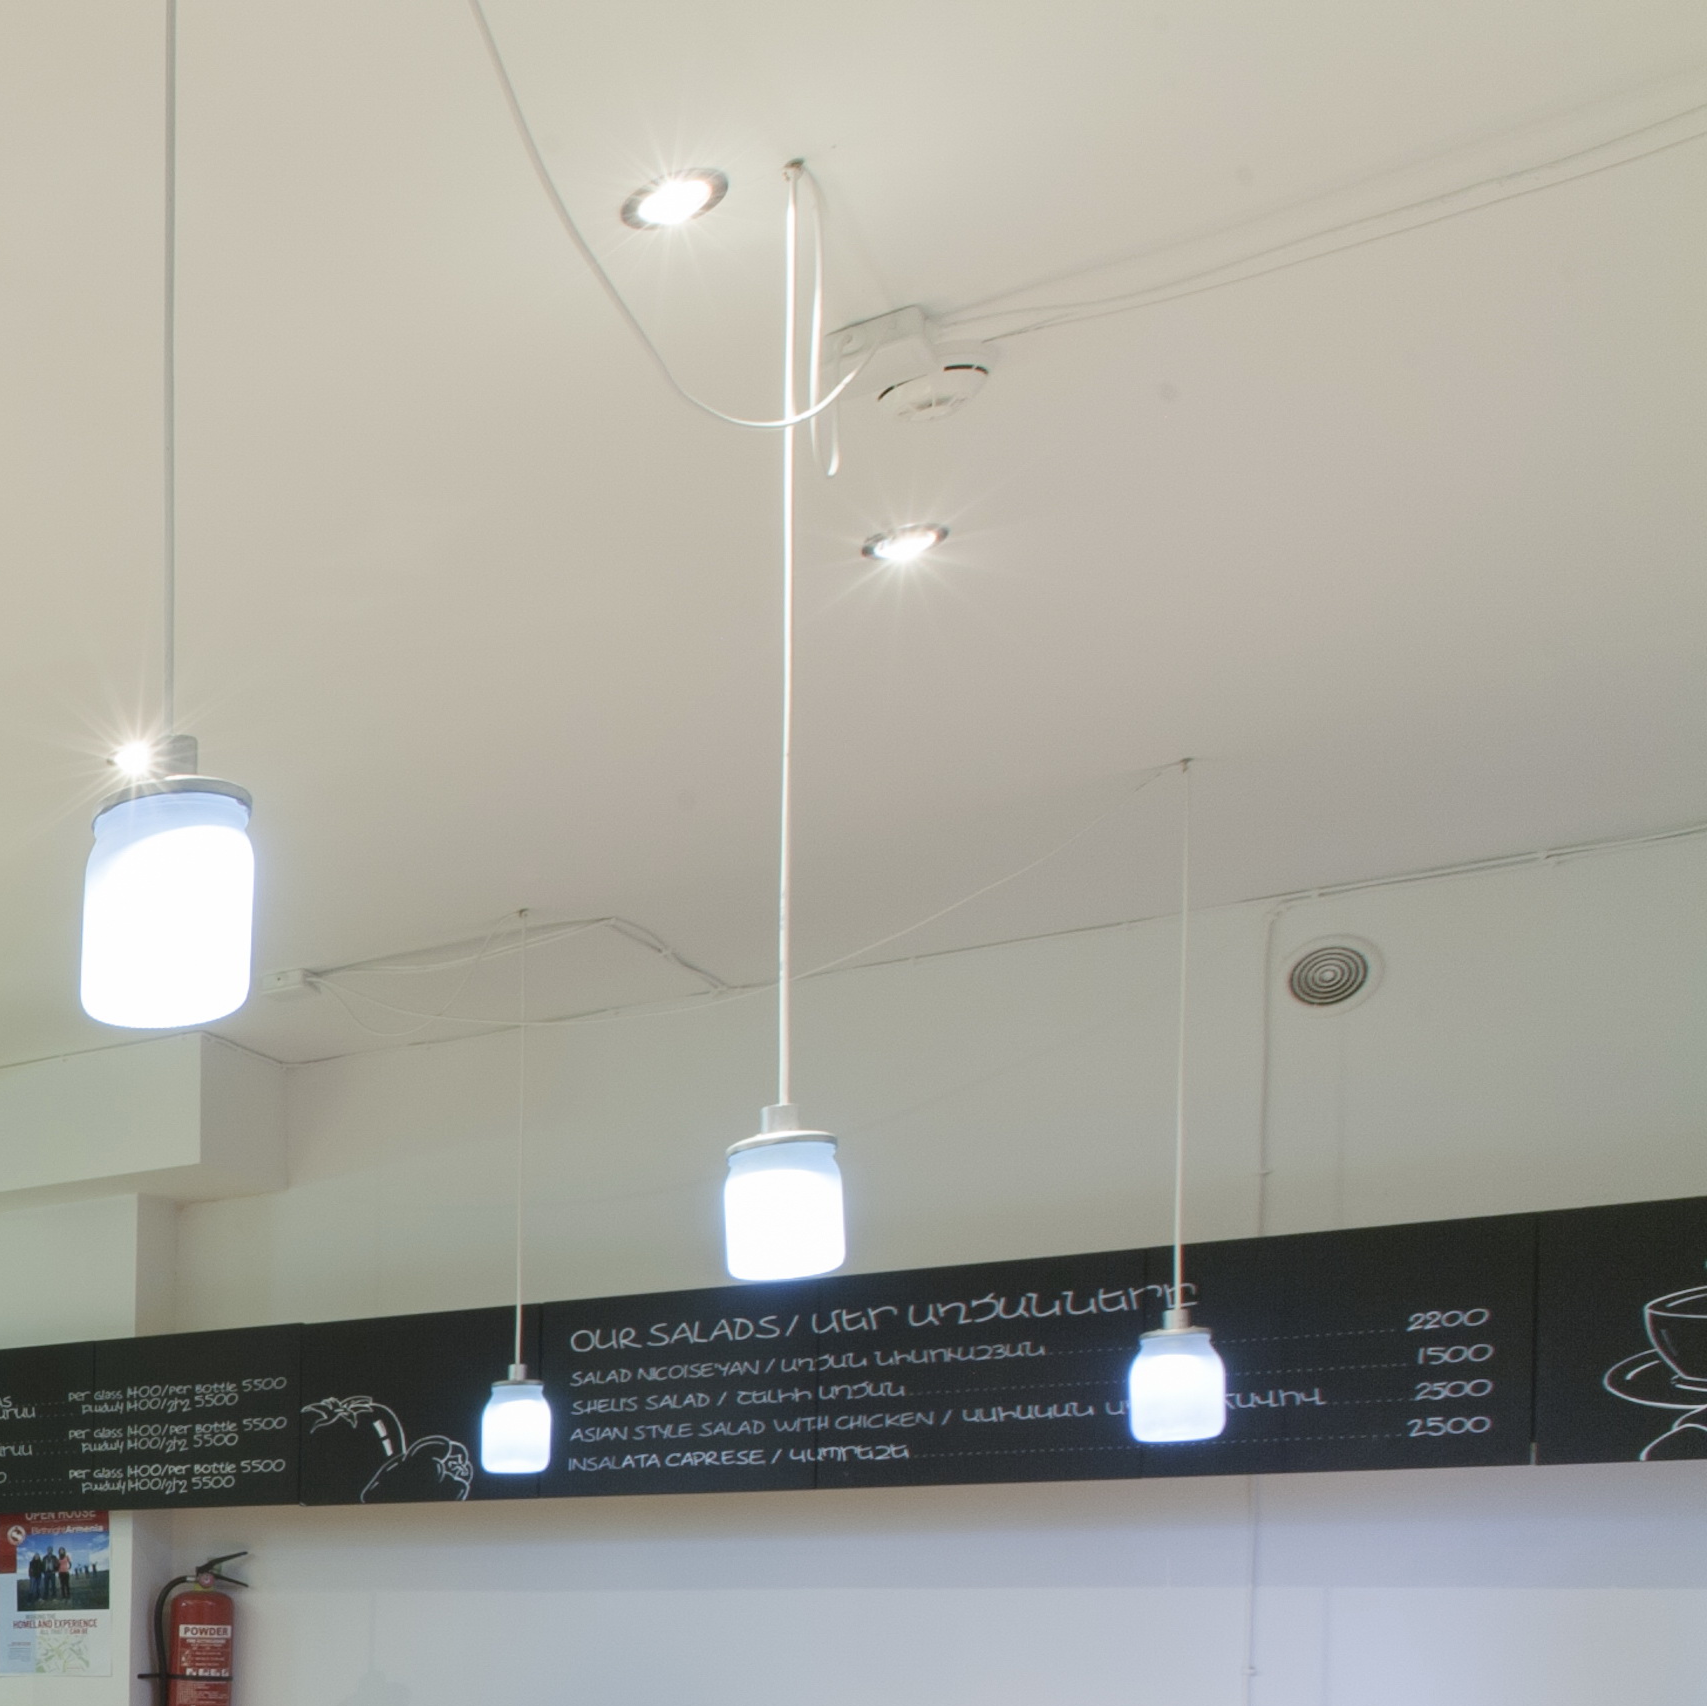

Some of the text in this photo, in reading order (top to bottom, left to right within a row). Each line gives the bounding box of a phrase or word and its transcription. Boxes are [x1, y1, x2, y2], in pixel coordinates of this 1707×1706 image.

[569, 1327, 642, 1353] OUR
[646, 1315, 782, 1347] SALADS
[570, 1368, 632, 1387] SALAD
[1406, 1307, 1491, 1333] 2200
[68, 1391, 90, 1402] per
[242, 1376, 287, 1391] 5500
[645, 1391, 710, 1411] SALAD
[1416, 1343, 1494, 1366] 1500
[194, 1393, 239, 1408] 5500
[570, 1378, 1494, 1443] ASIAN STYLE SALAD WITH CHICKEN 2500
[68, 1429, 90, 1441] per
[242, 1416, 287, 1431] 5500
[193, 1433, 239, 1448] 5500
[568, 1415, 1492, 1471] INSALATA CAPRESE 2500
[68, 1469, 90, 1480] per
[240, 1458, 286, 1473] 5500
[191, 1475, 236, 1490] 5500
[183, 1626, 229, 1636] POWDER
